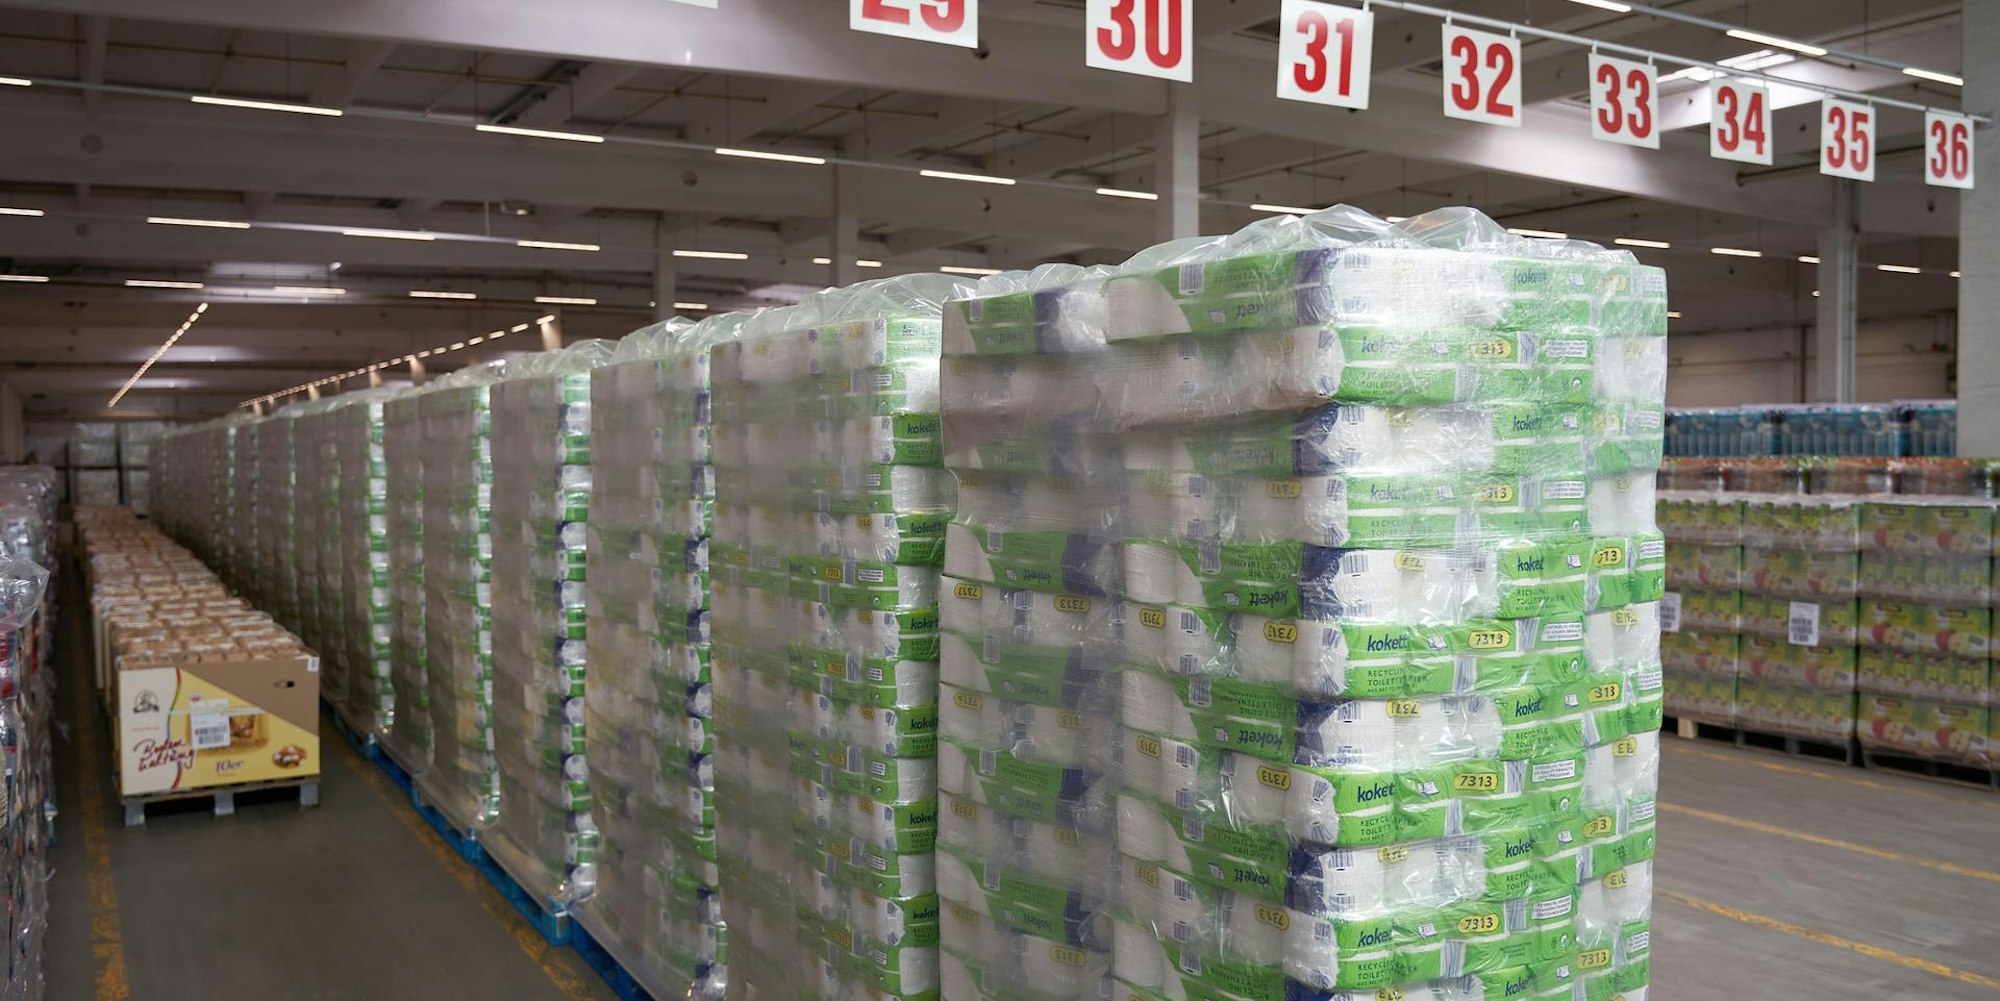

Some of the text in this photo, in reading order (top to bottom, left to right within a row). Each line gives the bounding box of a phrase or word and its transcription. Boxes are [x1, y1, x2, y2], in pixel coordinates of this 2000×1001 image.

[1096, 0, 1183, 68] 30
[1294, 18, 1352, 97] 31
[1450, 35, 1513, 117] 32
[1597, 63, 1651, 139] 33
[1717, 86, 1765, 155] 34
[1827, 107, 1869, 172] 35
[1931, 120, 1968, 179] 36
[1059, 598, 1086, 610] 7313
[1367, 633, 1408, 652] kokett
[1475, 633, 1504, 645] 7313
[1238, 729, 1284, 750] kokett
[216, 759, 244, 772] 10er
[1261, 770, 1287, 787] 7313
[1460, 775, 1493, 787] 7313
[1259, 908, 1284, 927] 7313
[1465, 917, 1493, 930] 7313
[1580, 952, 1607, 966] 7313
